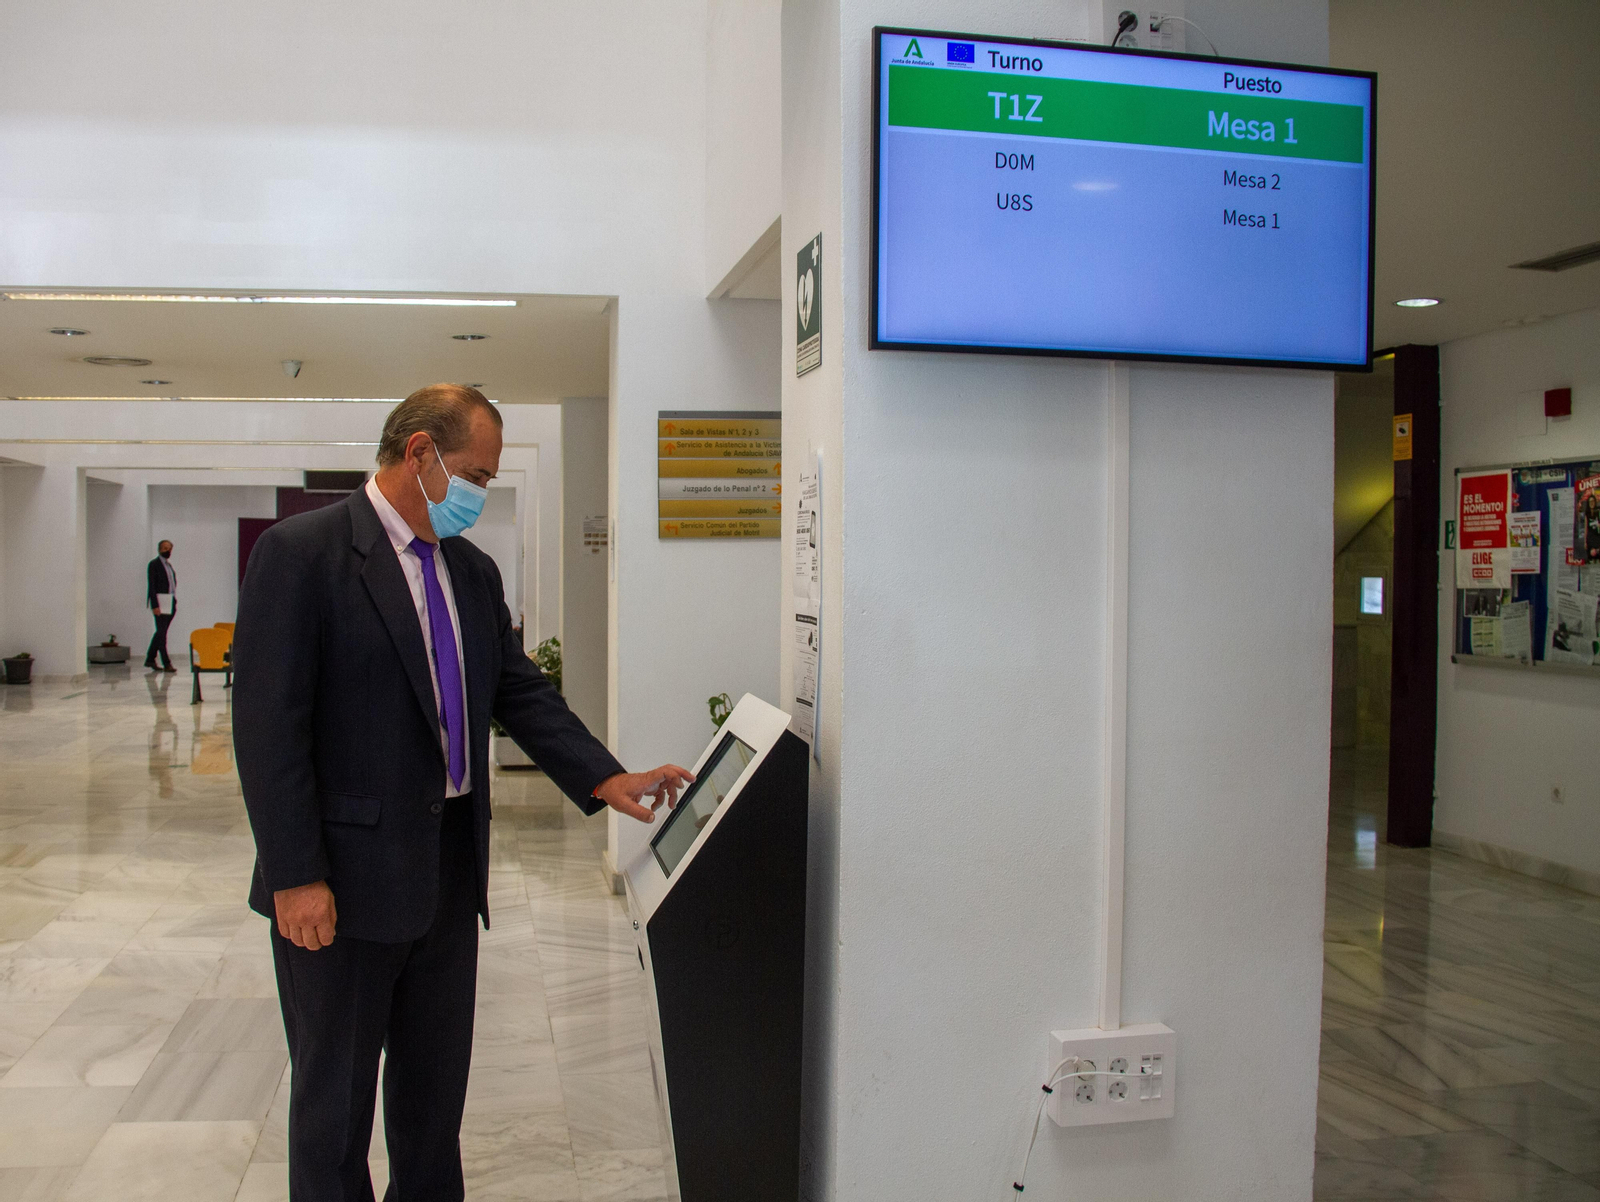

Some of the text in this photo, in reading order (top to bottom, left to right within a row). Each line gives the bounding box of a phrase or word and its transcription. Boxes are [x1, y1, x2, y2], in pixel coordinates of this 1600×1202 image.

[988, 50, 1043, 72] Turno
[1224, 72, 1282, 94] Puesto
[988, 91, 1043, 122] T1Z
[1208, 110, 1298, 144] Mesa 1
[1224, 170, 1280, 190] Mesa 2
[997, 193, 1033, 211] U8S
[1224, 209, 1280, 229] Mesa 1
[682, 485, 711, 493] Juzgado
[1464, 493, 1483, 504] ES EL
[1463, 502, 1503, 514] MOMENTO!
[1472, 552, 1492, 565] ELIGE
